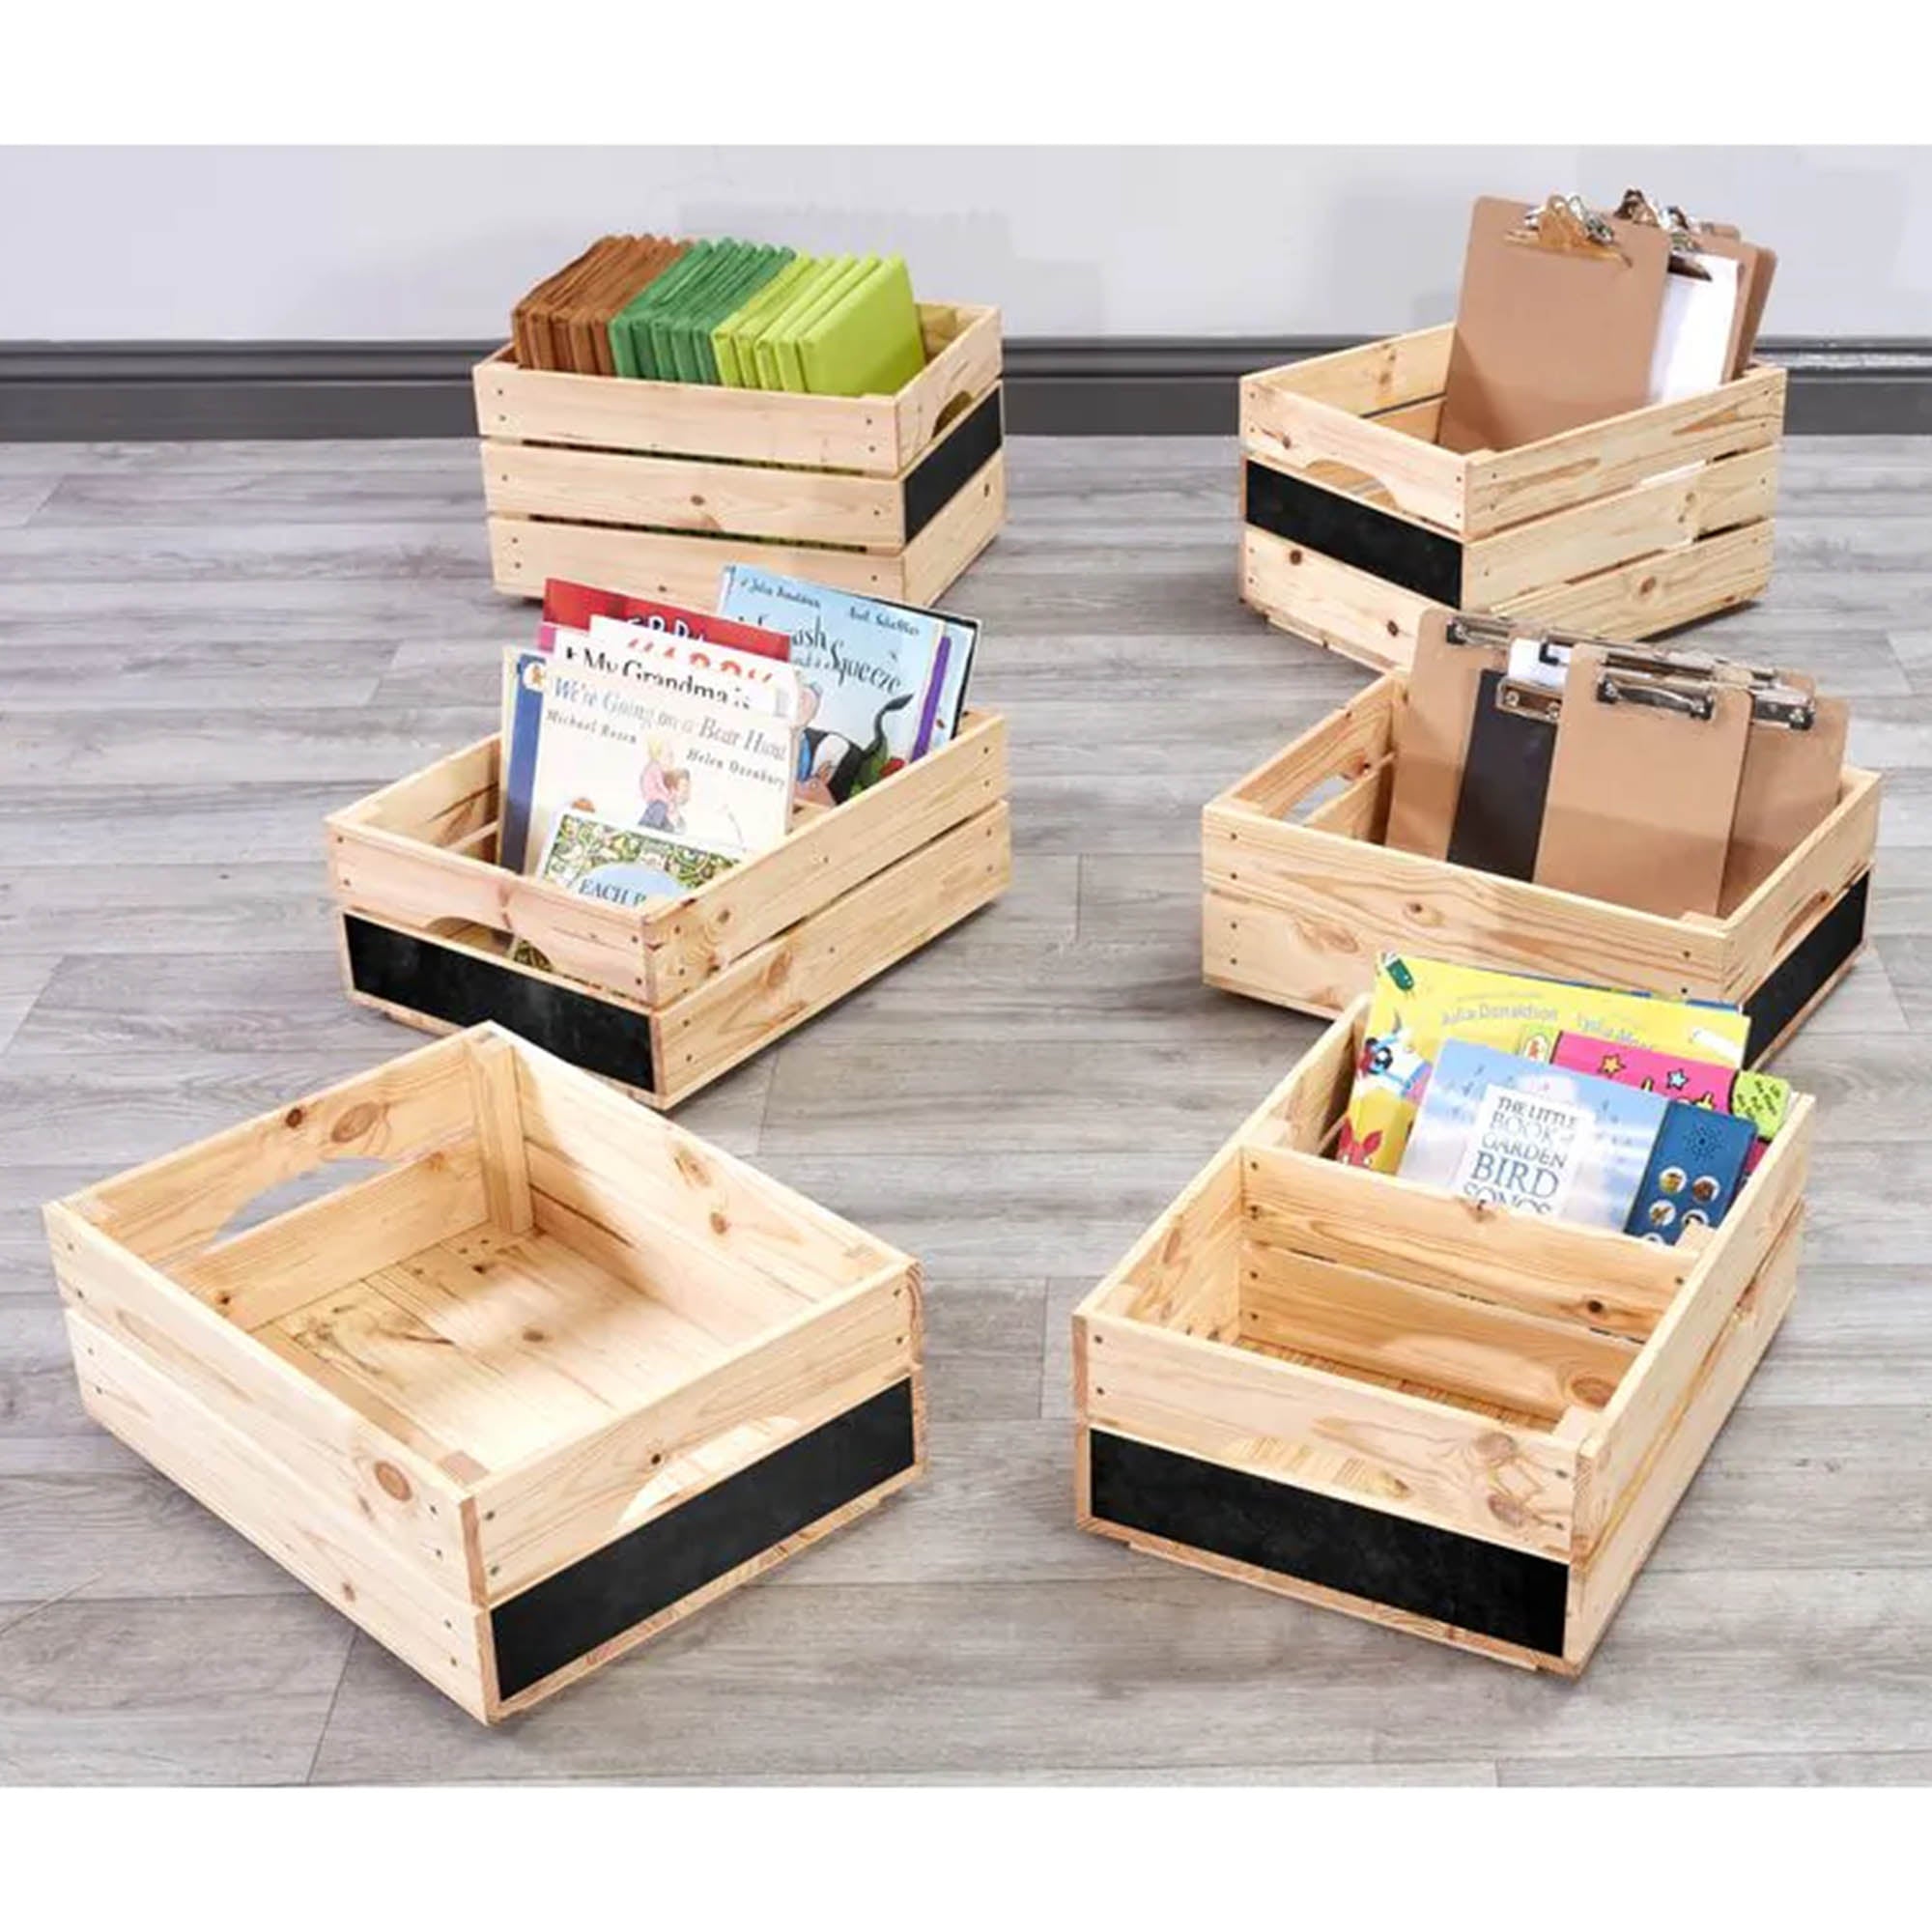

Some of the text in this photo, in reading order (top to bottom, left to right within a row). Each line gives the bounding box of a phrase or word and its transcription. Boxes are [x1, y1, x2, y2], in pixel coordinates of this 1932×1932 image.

[622, 659, 728, 704] Grandma
[830, 639, 901, 694] Squeeze
[546, 709, 638, 745] Michael Rosen
[554, 676, 598, 707] We're
[603, 691, 654, 730] Going
[658, 712, 680, 730] on
[699, 716, 741, 747] Bear
[743, 728, 787, 761] Hunt
[687, 748, 786, 790] Helen Oxenbury
[1478, 1002, 1559, 1024] Donaldson
[1491, 1110, 1554, 1147] BOOK
[1498, 1095, 1577, 1129] THE LITTLE
[1482, 1131, 1568, 1169] GARDEN
[1470, 1150, 1560, 1198] BIRD
